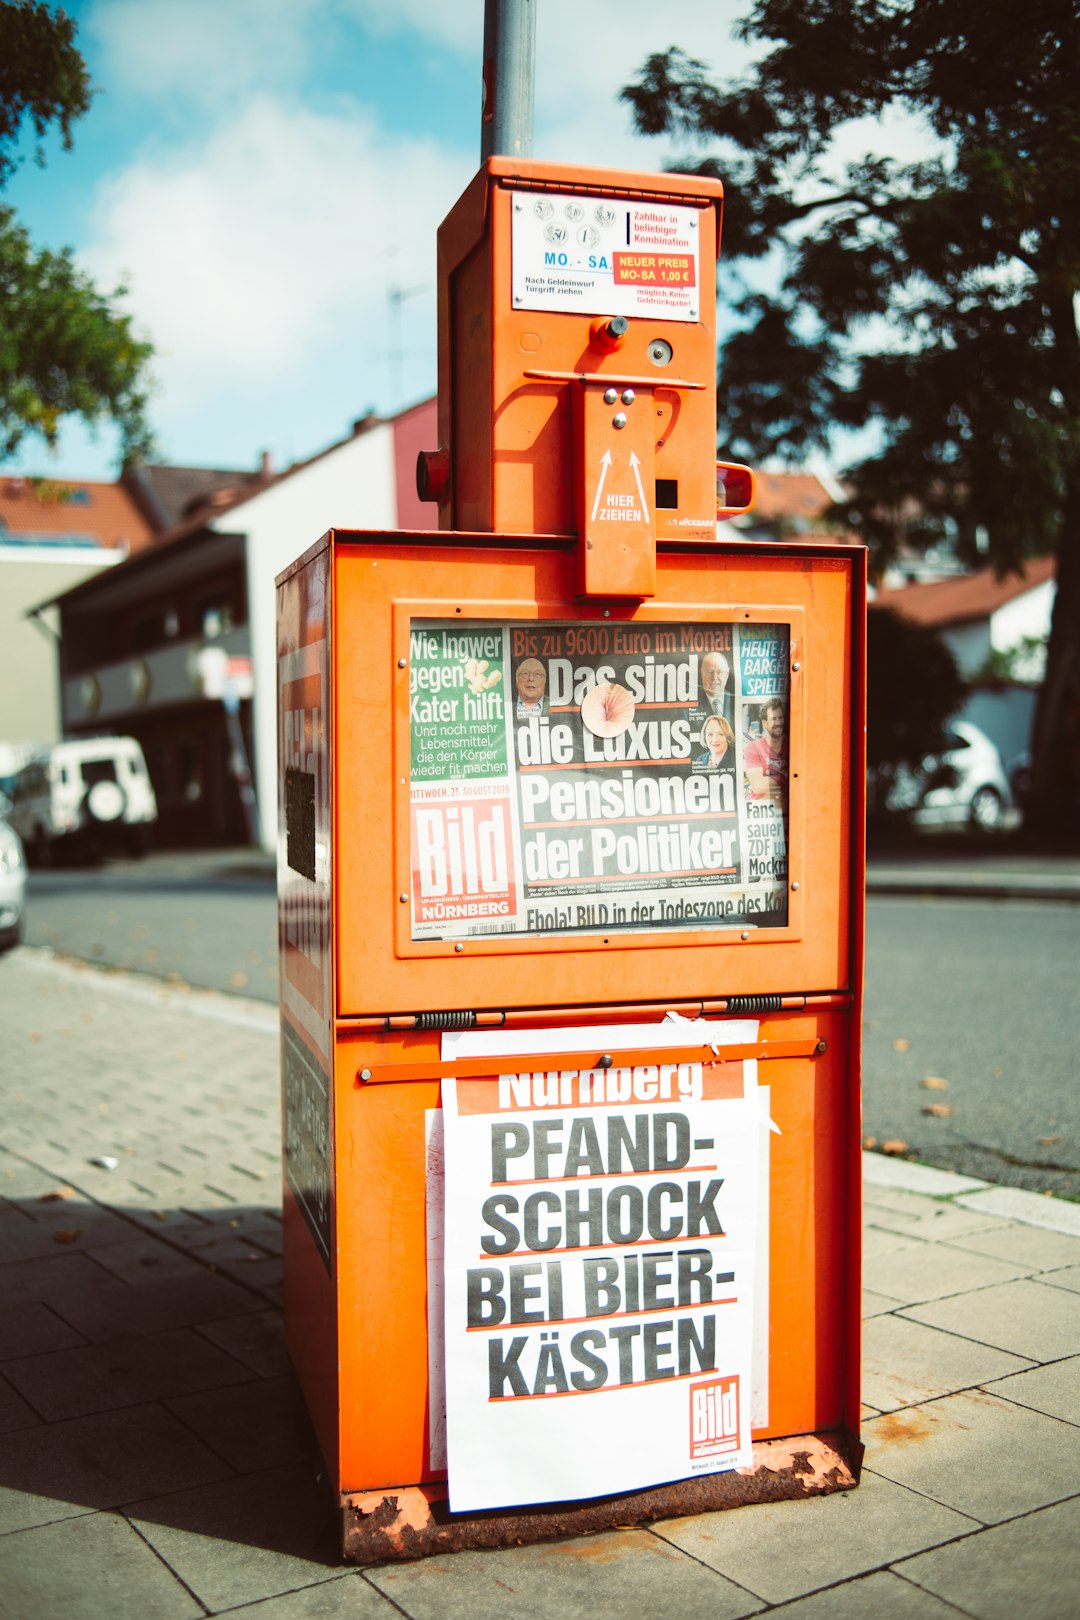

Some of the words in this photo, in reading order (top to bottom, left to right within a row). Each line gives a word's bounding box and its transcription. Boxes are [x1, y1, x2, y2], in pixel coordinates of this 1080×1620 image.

[634, 211, 667, 223] Zahlbar
[669, 213, 678, 223] in
[634, 223, 678, 236] beliebiger
[634, 236, 689, 248] Kombination
[619, 256, 656, 268] NEUER
[658, 257, 689, 269] PREIS
[525, 276, 545, 285] Nach
[547, 277, 595, 288] Geldeinwurf
[620, 270, 656, 280] MO-SA
[661, 271, 681, 282] 1,00
[682, 271, 690, 282] €
[525, 285, 555, 294] Türgriff
[557, 288, 583, 296] ziehen
[637, 297, 691, 308] Geldrückgabe!
[606, 494, 634, 507] HIER
[599, 509, 642, 522] ZIEHEN
[442, 631, 502, 663] Ingwer
[513, 630, 538, 658] Bis
[541, 637, 561, 657] zu
[565, 627, 609, 656] 9600
[613, 627, 651, 655] Euro
[655, 626, 676, 653] im
[680, 625, 732, 652] Monat
[741, 640, 778, 658] HEUTE
[624, 654, 699, 705] sind
[746, 677, 787, 695] SPIELE
[410, 695, 459, 723] Kater
[463, 692, 504, 721] hilft
[414, 724, 438, 737] Und
[440, 723, 467, 736] noch
[469, 722, 498, 735] mehr
[420, 735, 493, 751] Lebensmittel,
[517, 716, 574, 766] die
[582, 719, 701, 763] Luxus-
[416, 751, 435, 763] die
[436, 750, 458, 762] den
[460, 747, 498, 763] Körper
[410, 763, 446, 777] wieder
[449, 762, 461, 775] fit
[463, 761, 507, 774] machen
[520, 769, 736, 823] Pensionen
[747, 822, 782, 838] sauer
[415, 804, 509, 898] Bild
[524, 831, 584, 881] der
[590, 823, 737, 877] Politiker
[748, 839, 770, 857] ZDF
[422, 901, 510, 920] NÜRNBERG
[576, 903, 609, 927] BILD
[613, 902, 627, 924] in
[631, 900, 655, 922] der
[658, 897, 734, 922] Todeszone
[737, 893, 761, 915] des
[491, 1112, 715, 1183] PFAND-
[480, 1178, 725, 1255] SCHOCK
[466, 1260, 564, 1328] BEI
[582, 1248, 735, 1318] BIER-
[488, 1314, 717, 1398] KÄSTEN
[692, 1382, 738, 1443] Bild
